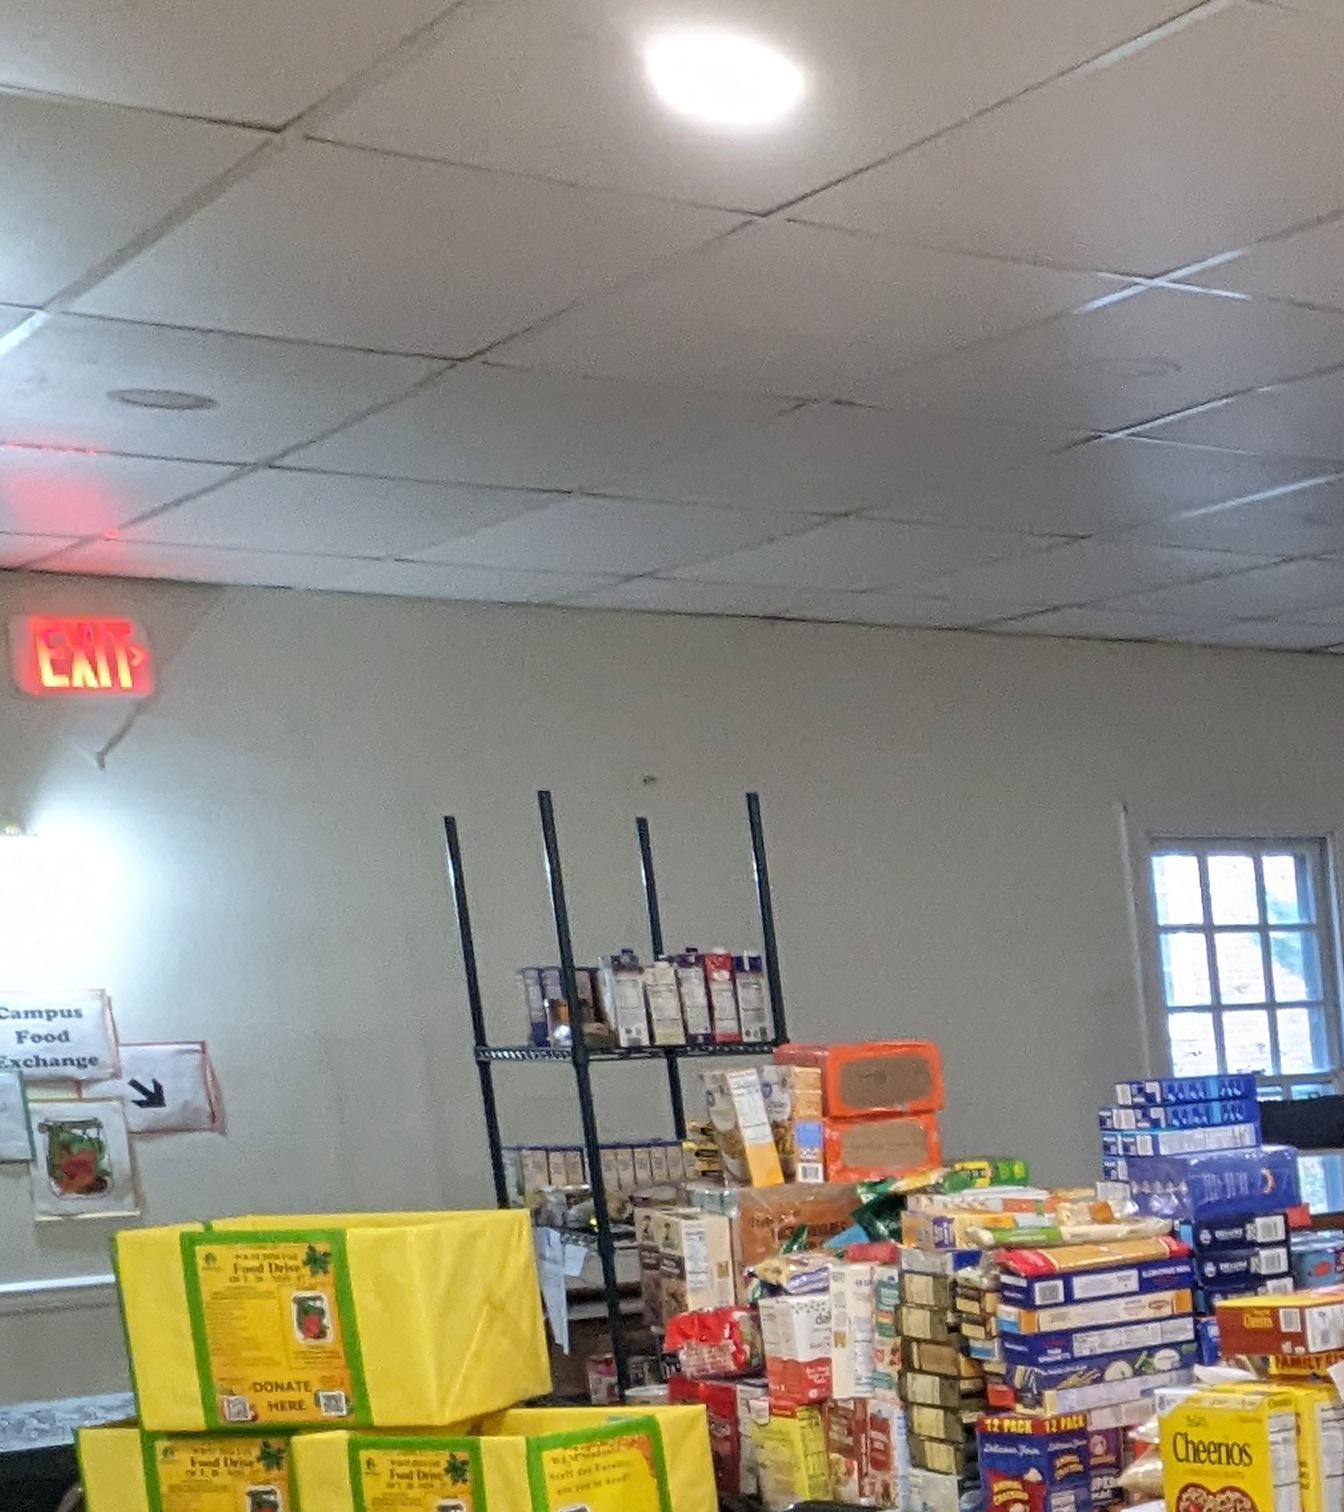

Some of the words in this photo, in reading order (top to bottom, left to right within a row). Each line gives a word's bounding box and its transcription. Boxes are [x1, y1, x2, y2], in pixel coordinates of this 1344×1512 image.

[34, 615, 134, 689] EXIT
[15, 1029, 71, 1044] Food
[252, 1380, 312, 1393] DONATE
[267, 1400, 307, 1412] HERE
[983, 1418, 1000, 1431] 12
[1003, 1419, 1033, 1434] PACK
[1044, 1420, 1058, 1433] 12
[1061, 1414, 1086, 1430] PACK
[1172, 1432, 1253, 1467] Cheerios
